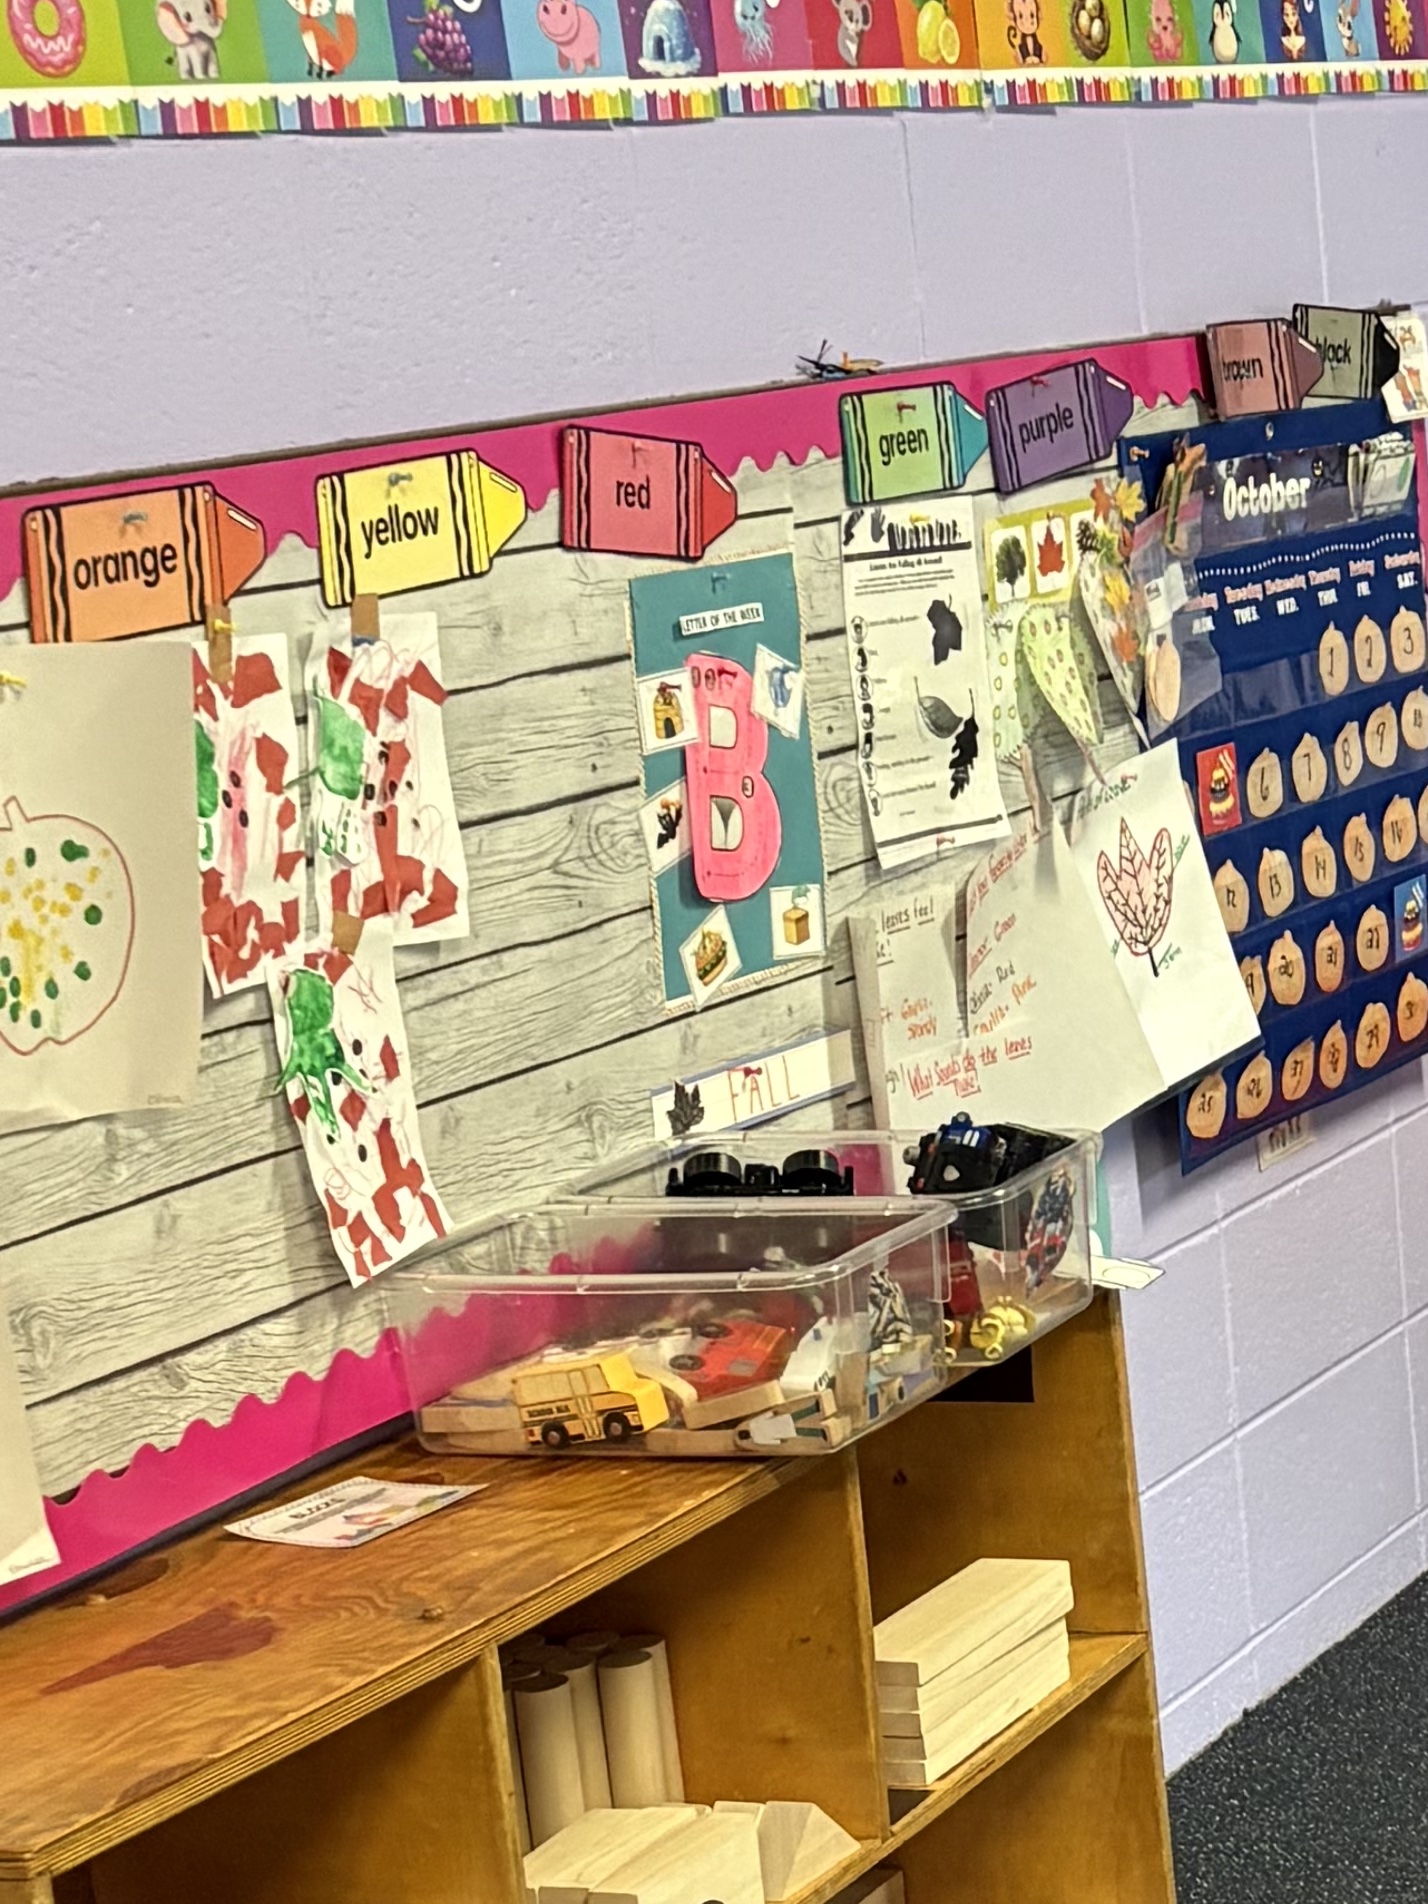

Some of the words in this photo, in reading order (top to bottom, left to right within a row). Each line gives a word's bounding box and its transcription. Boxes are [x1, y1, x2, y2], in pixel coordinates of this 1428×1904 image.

[1221, 356, 1265, 383] brown
[878, 422, 930, 468] green
[1017, 404, 1075, 452] purple
[613, 474, 652, 511] red
[1222, 472, 1311, 522] October
[360, 501, 441, 559] yellow
[72, 540, 179, 592] orange
[1403, 627, 1414, 655] 3
[1259, 767, 1270, 802] 6
[1303, 753, 1312, 782] 7
[1343, 736, 1353, 772] 8
[1375, 721, 1387, 754] 9
[1268, 874, 1282, 901] 13
[1353, 836, 1366, 863] 15
[727, 1055, 801, 1124] FALL
